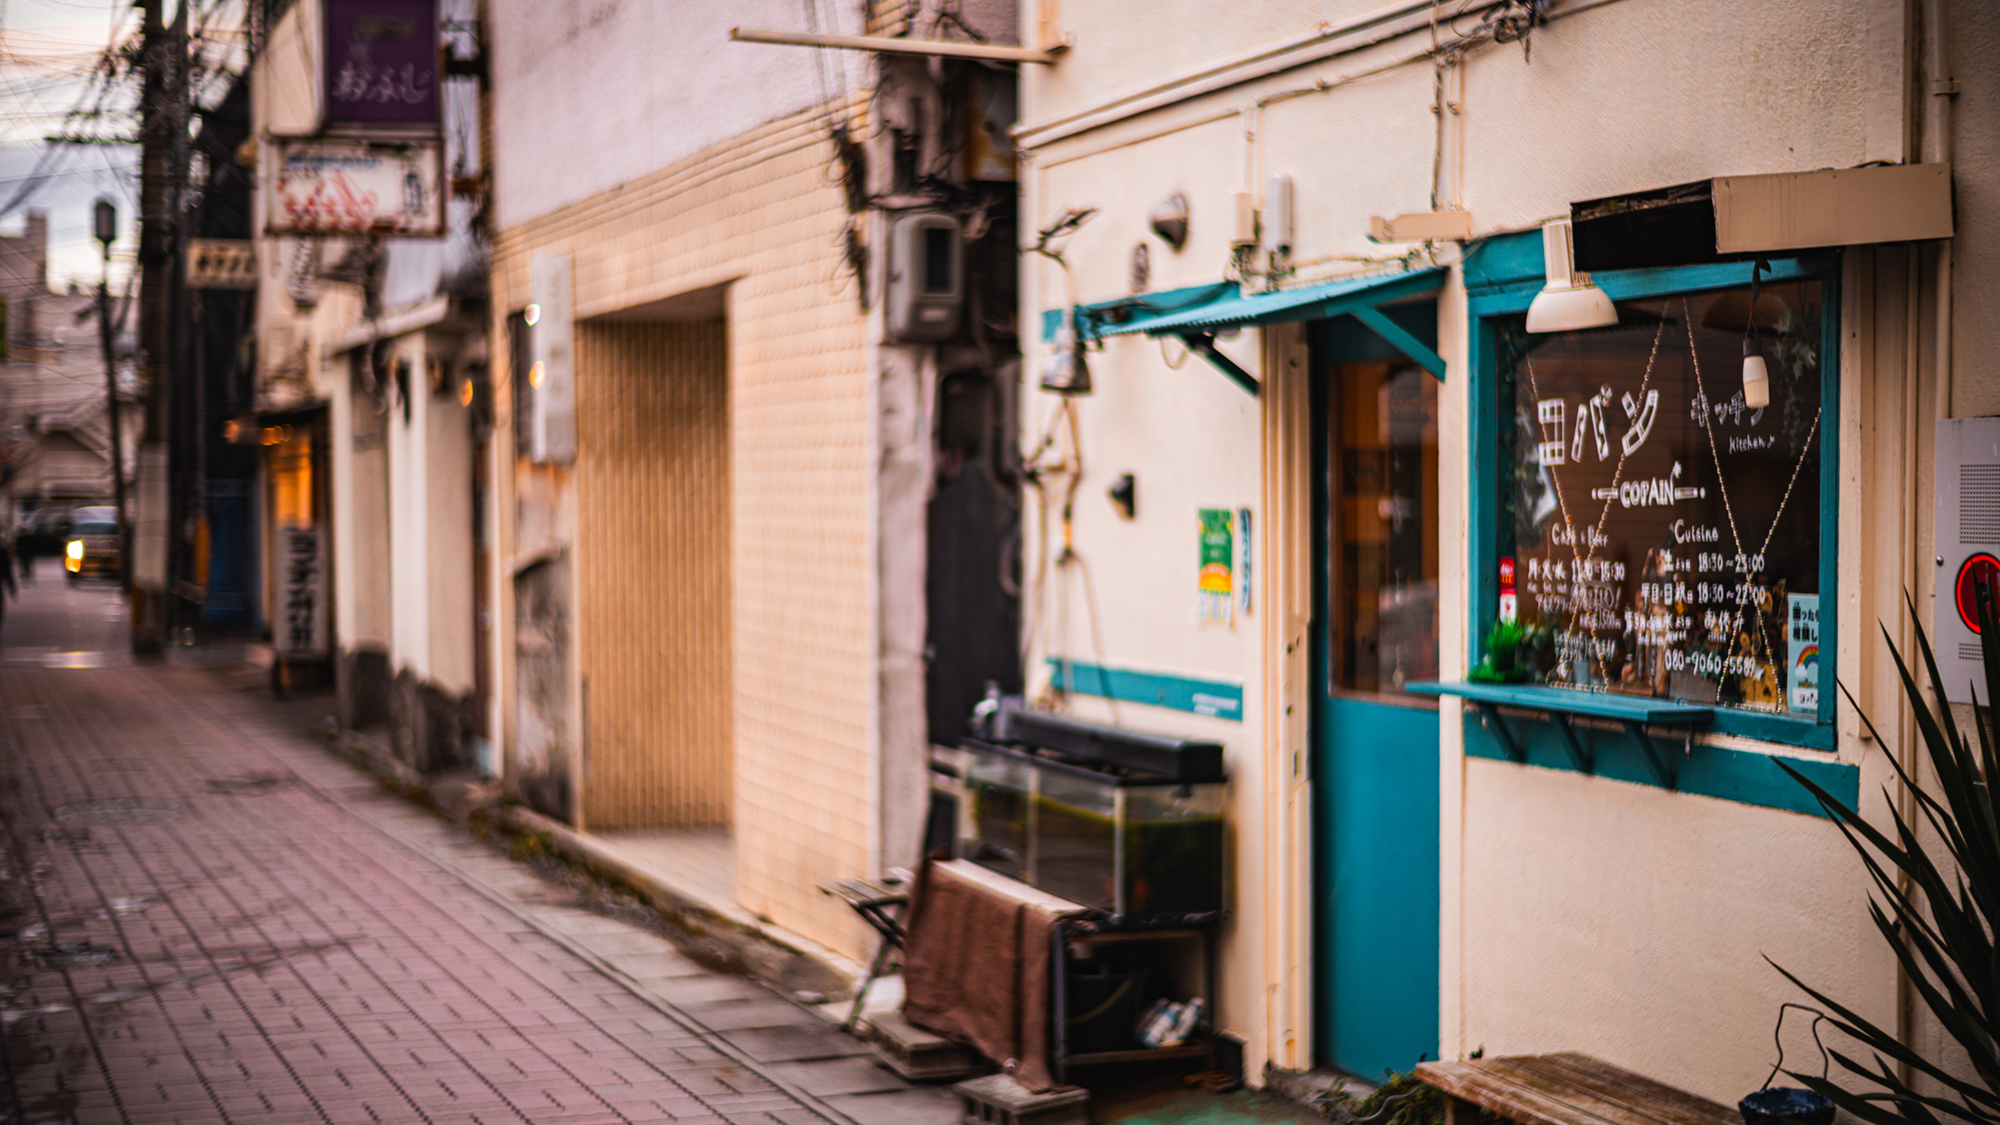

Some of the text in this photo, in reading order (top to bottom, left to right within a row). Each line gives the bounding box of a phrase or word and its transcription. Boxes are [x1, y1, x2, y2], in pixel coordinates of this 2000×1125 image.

[1537, 384, 1658, 465] コパン
[1620, 477, 1674, 508] COPAIN
[1675, 519, 1719, 544] Cuisine
